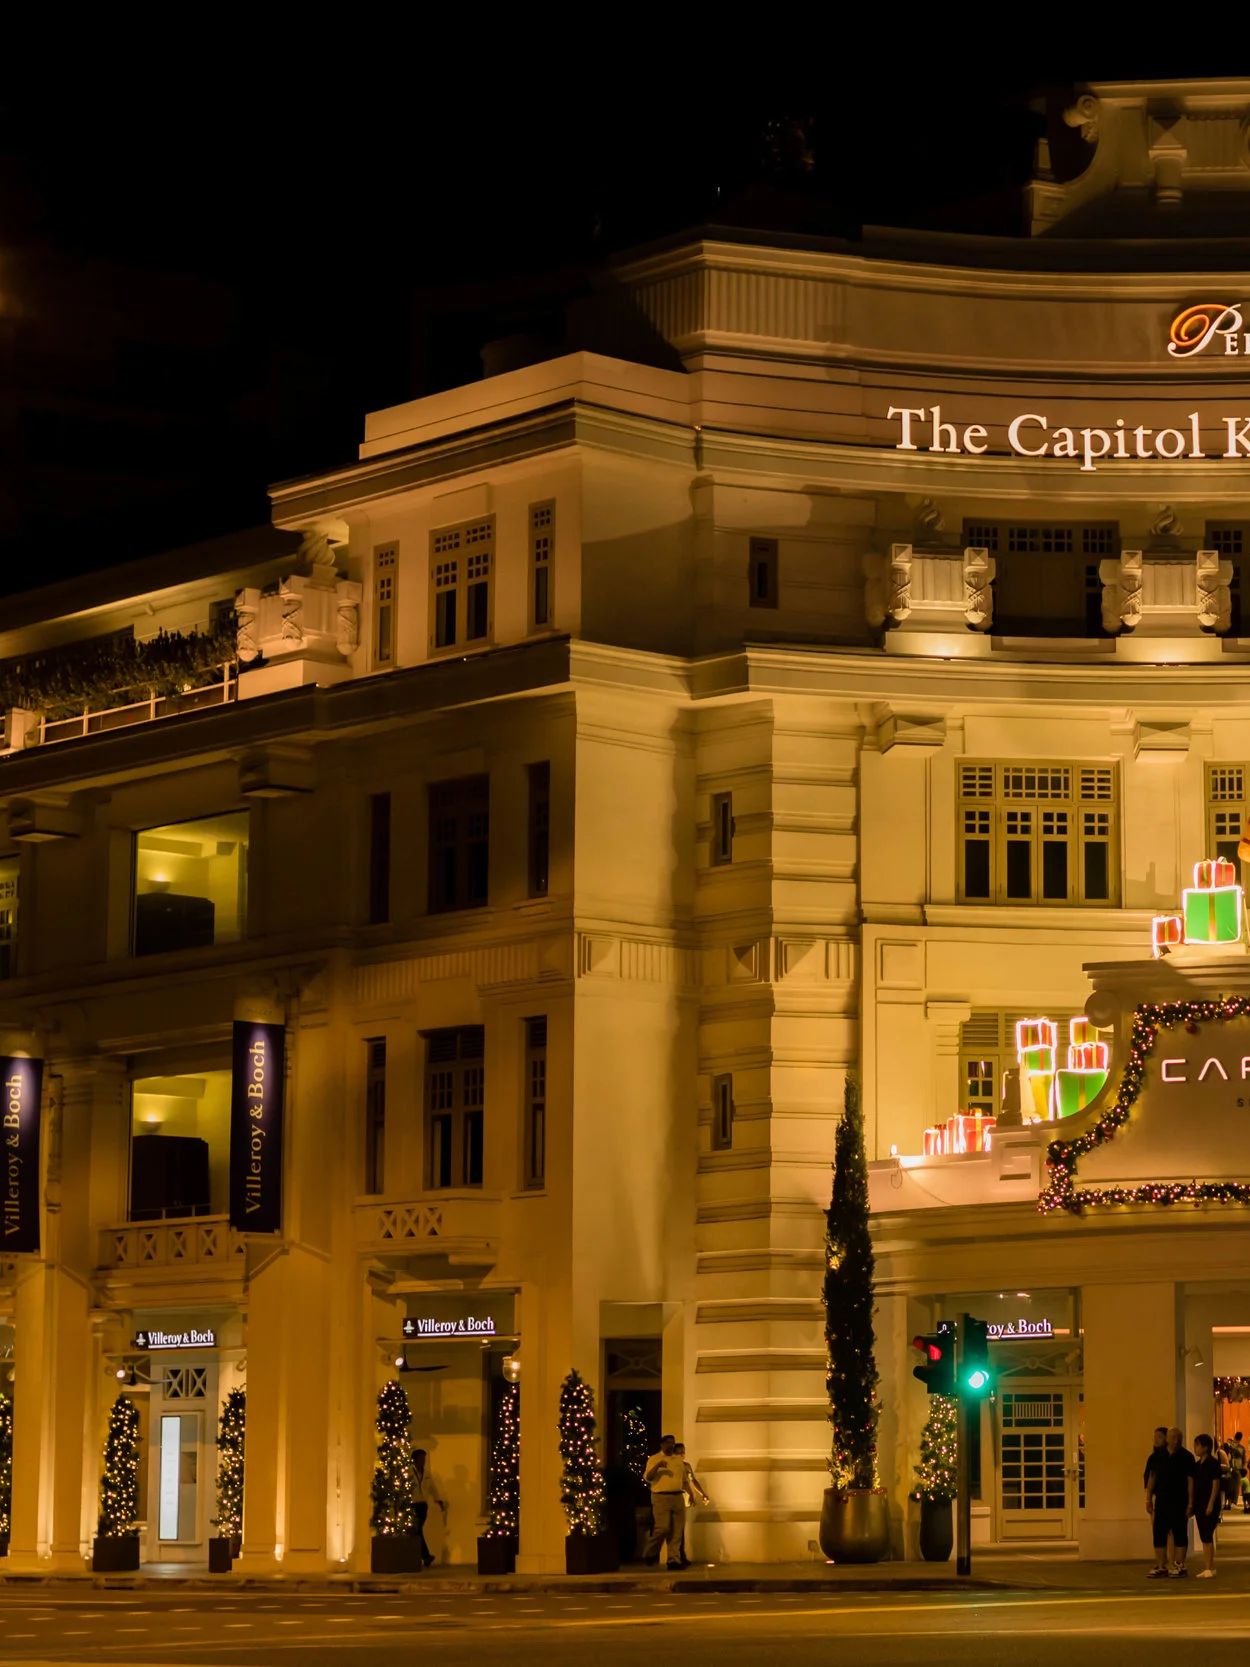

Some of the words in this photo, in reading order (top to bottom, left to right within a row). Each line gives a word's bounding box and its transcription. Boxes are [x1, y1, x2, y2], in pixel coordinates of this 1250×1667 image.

[886, 405, 989, 455] The
[1007, 412, 1206, 472] Capitol
[247, 1040, 266, 1100] Boch
[3, 1073, 23, 1130] Boch
[249, 1103, 264, 1120] &
[6, 1133, 20, 1149] &
[245, 1124, 266, 1216] Villeroy
[3, 1152, 24, 1237] Villeroy
[148, 1331, 182, 1347] Villeroy
[182, 1332, 190, 1343] &
[190, 1329, 214, 1343] Boch
[417, 1318, 457, 1335] Villeroy
[458, 1319, 466, 1331] &
[467, 1316, 494, 1331] Boch
[1007, 1322, 1016, 1334] &
[1018, 1318, 1052, 1334] Boch
